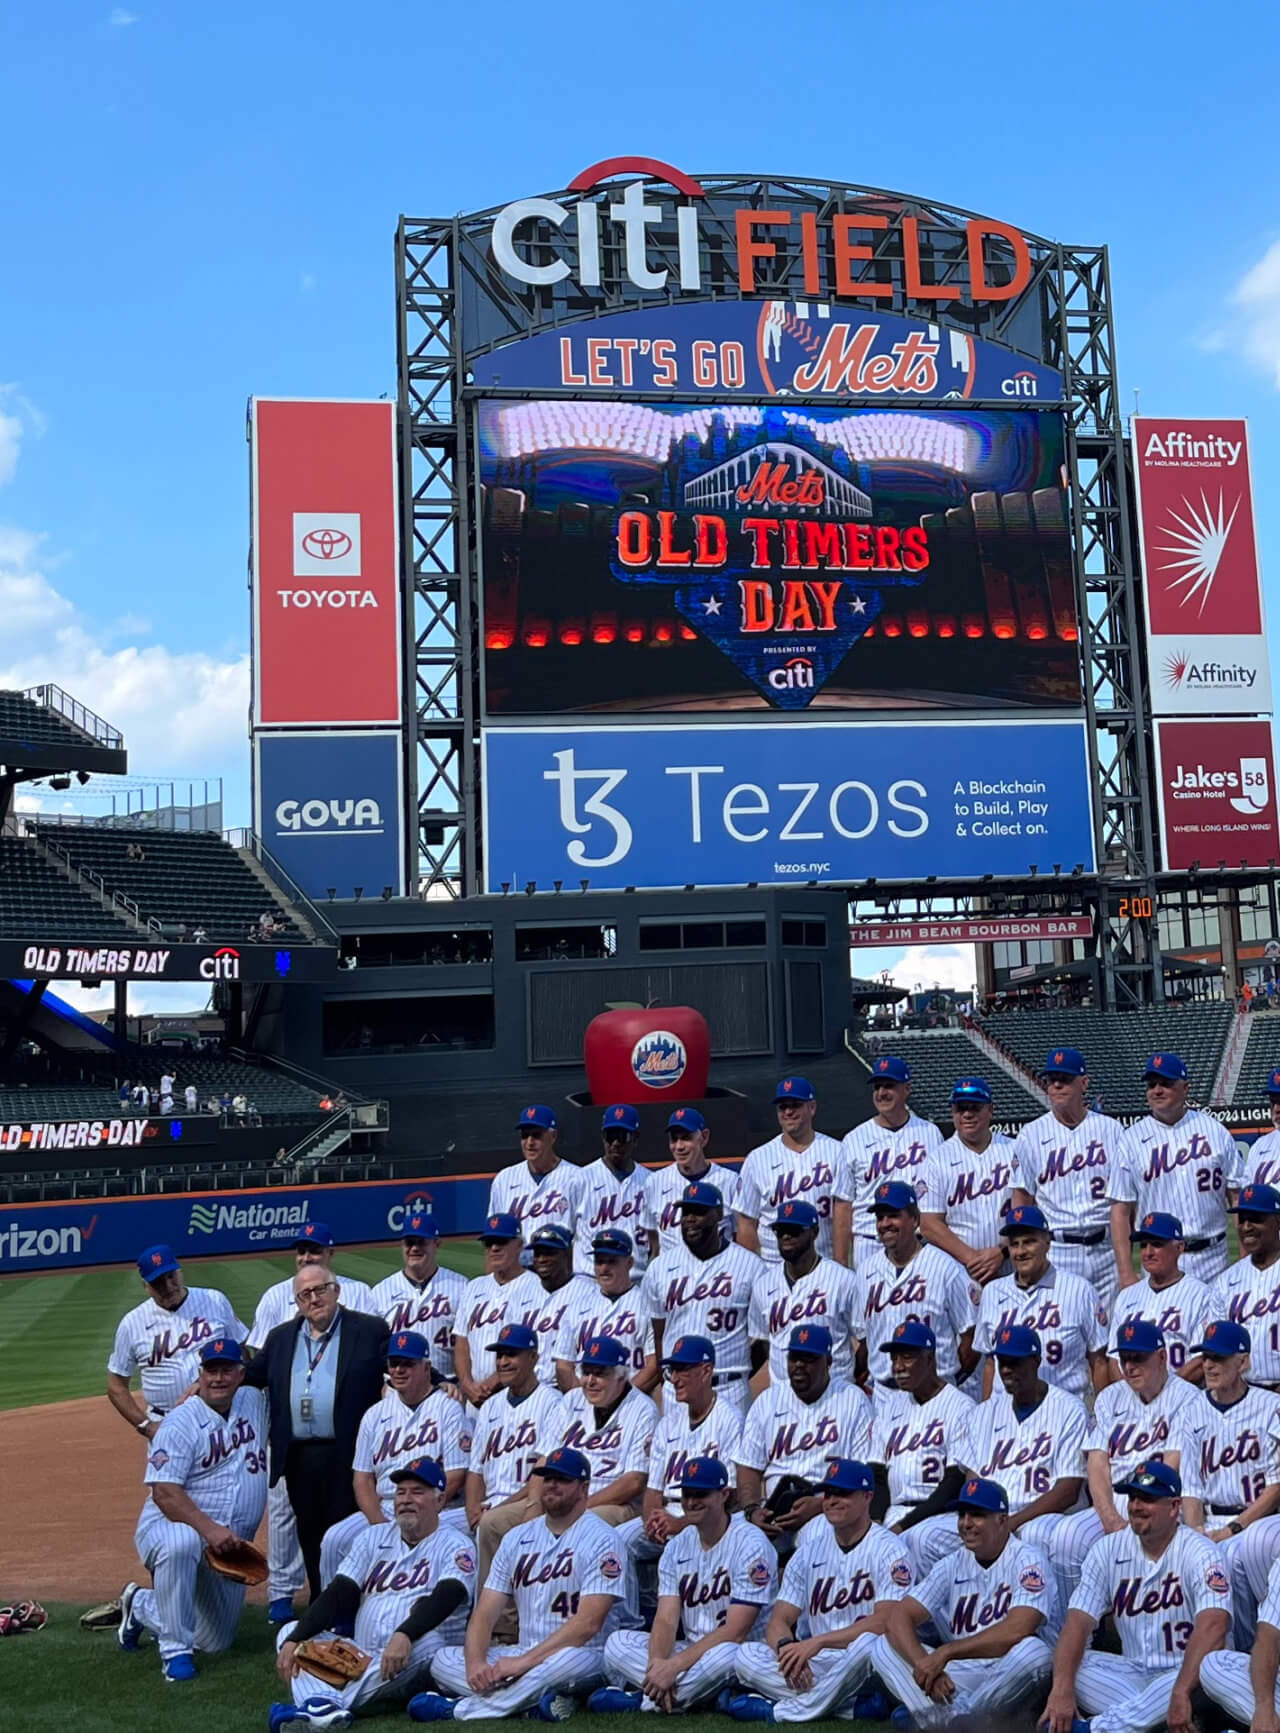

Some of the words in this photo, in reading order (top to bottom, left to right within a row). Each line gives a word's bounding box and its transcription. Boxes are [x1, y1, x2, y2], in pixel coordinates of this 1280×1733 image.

[492, 181, 700, 290] citi
[736, 209, 1031, 300] FIELD
[560, 336, 678, 388] LET'S
[692, 340, 744, 389] GO
[794, 323, 940, 394] Mets
[1001, 376, 1038, 396] citi
[1144, 432, 1242, 466] Affinity
[737, 461, 825, 507] Mets
[617, 511, 729, 571] OLD
[743, 518, 931, 573] TIMERS
[277, 590, 377, 609] TOYOTA
[739, 580, 842, 633] DAY
[768, 663, 814, 690] citi
[1187, 663, 1257, 687] Affinity
[953, 781, 964, 795] A
[970, 779, 1046, 796] Blockchain
[1170, 765, 1239, 788] Jake's
[1244, 772, 1265, 786] 58
[1173, 790, 1200, 798] Casino
[1203, 790, 1225, 798] Hotel
[275, 798, 382, 831] GOYA
[664, 765, 930, 843] Tezos
[954, 801, 969, 816] to
[973, 801, 1014, 818] Build,
[1018, 801, 1049, 819] Play
[956, 822, 968, 837] &
[971, 820, 1023, 837] Collect
[1026, 823, 1048, 835] on.
[1201, 824, 1222, 832] LONG
[774, 860, 830, 875] tezos.nyc
[849, 929, 880, 940] THE
[886, 928, 912, 939] JIM
[919, 926, 962, 938] BEAM
[968, 923, 1040, 936] BOURBON
[1047, 921, 1078, 933] BAR
[24, 946, 63, 974] OLD
[65, 949, 129, 974] TIMERS
[133, 949, 170, 975] DAY
[200, 955, 239, 979] citi
[1241, 1109, 1273, 1122] LIGH
[0, 1124, 22, 1151] LD
[30, 1120, 103, 1149] TIMERS
[106, 1118, 148, 1146] DAY
[864, 1140, 926, 1183] Mets
[1039, 1139, 1107, 1185] Mets
[1143, 1132, 1213, 1182] Mets
[215, 1200, 309, 1229] National
[0, 1223, 81, 1258] rizon
[248, 1229, 268, 1241] Car
[270, 1227, 300, 1239] Rent
[664, 1270, 734, 1312] Mets
[864, 1275, 927, 1320] Mets
[706, 1306, 738, 1333] 30
[770, 1289, 828, 1335] Mets
[148, 1316, 213, 1368] Mets
[202, 1417, 256, 1470] Mets
[481, 1419, 537, 1465] Mets
[563, 1420, 622, 1451] Mets
[768, 1415, 838, 1462] Mets
[885, 1418, 944, 1461] Mets
[1201, 1429, 1261, 1475] Mets
[981, 1432, 1053, 1478] Mets
[1024, 1467, 1050, 1493] 16
[361, 1558, 431, 1597] Mets
[510, 1548, 573, 1589] Mets
[679, 1565, 731, 1609] Mets
[809, 1570, 875, 1617] Mets
